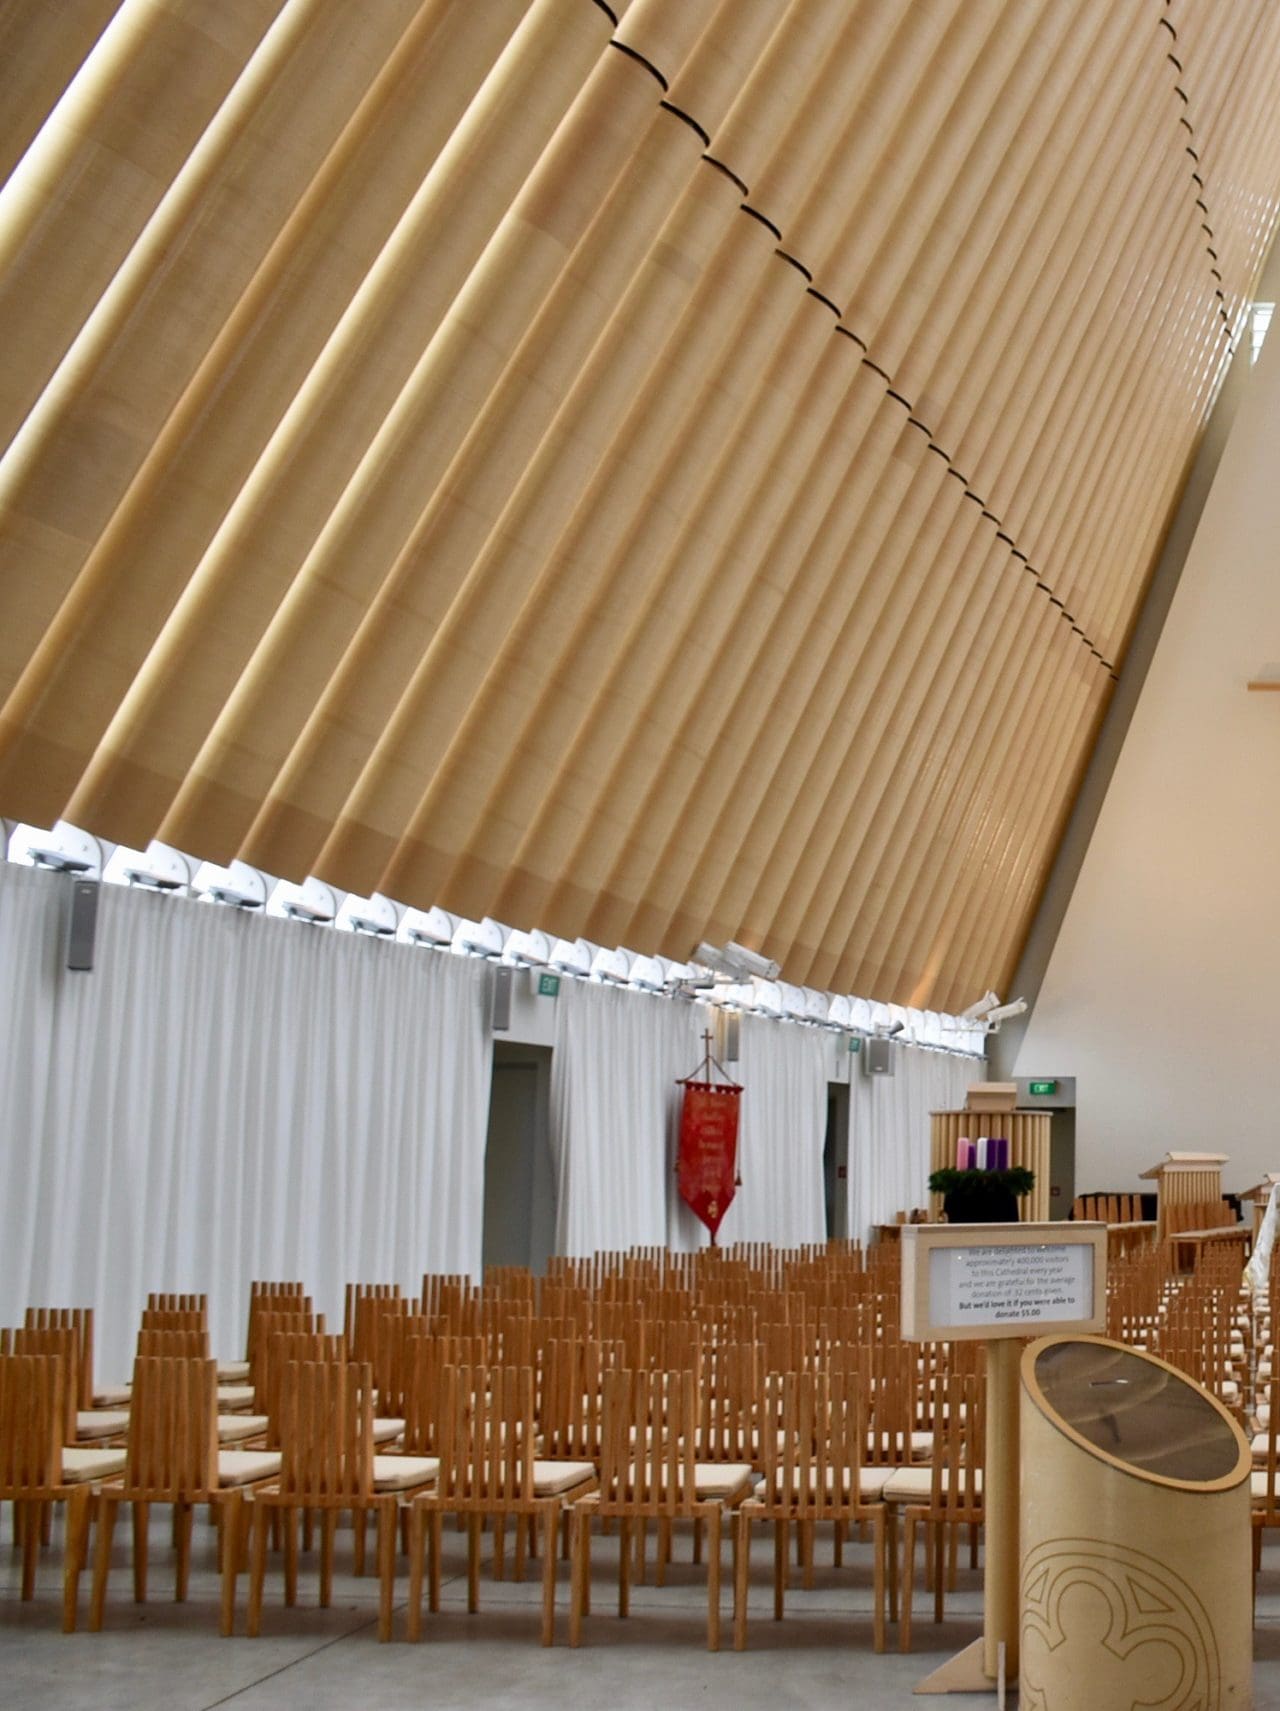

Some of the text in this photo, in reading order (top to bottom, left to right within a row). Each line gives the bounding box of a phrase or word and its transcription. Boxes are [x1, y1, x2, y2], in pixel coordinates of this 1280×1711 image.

[966, 1257, 1014, 1268] approximately
[1045, 1255, 1069, 1263] visitors
[971, 1266, 1063, 1277] to this Cathedral every year
[959, 1280, 972, 1288] and
[986, 1280, 997, 1288] are
[998, 1279, 1025, 1288] grateful
[1026, 1277, 1036, 1285] for
[1037, 1276, 1049, 1284] the
[1050, 1276, 1075, 1285] average
[971, 1289, 1003, 1298] donation
[1004, 1288, 1012, 1297] of
[1024, 1287, 1043, 1296] cents
[959, 1302, 972, 1310] But
[991, 1299, 1006, 1308] love
[1006, 1299, 1012, 1307] it
[1013, 1298, 1019, 1307] if
[1020, 1300, 1033, 1308] you
[1052, 1296, 1066, 1305] able
[1067, 1296, 1075, 1304] to
[995, 1310, 1020, 1319] donate
